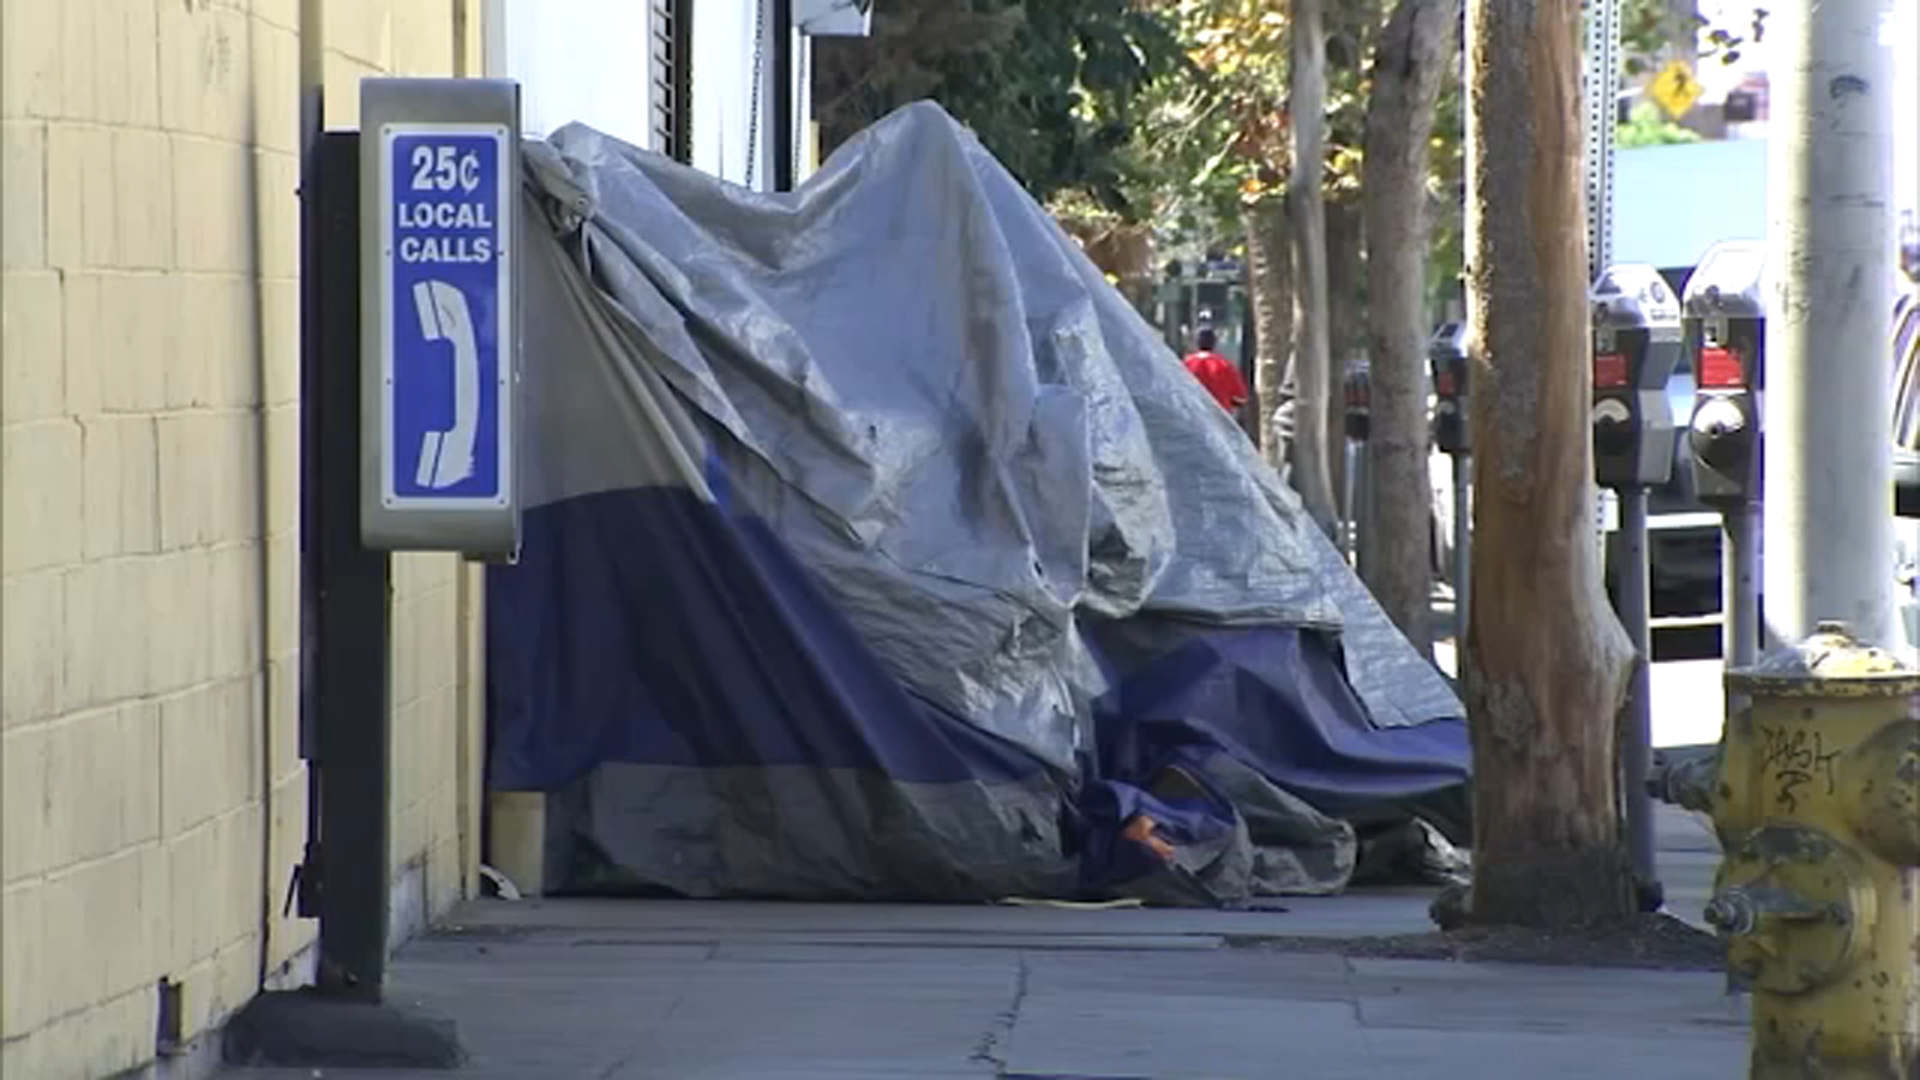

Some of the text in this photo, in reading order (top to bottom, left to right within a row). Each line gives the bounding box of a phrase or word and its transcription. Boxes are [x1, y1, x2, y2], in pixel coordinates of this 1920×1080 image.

[412, 146, 480, 194] 25¢
[398, 203, 492, 228] LOCAL
[400, 237, 492, 263] CALLS
